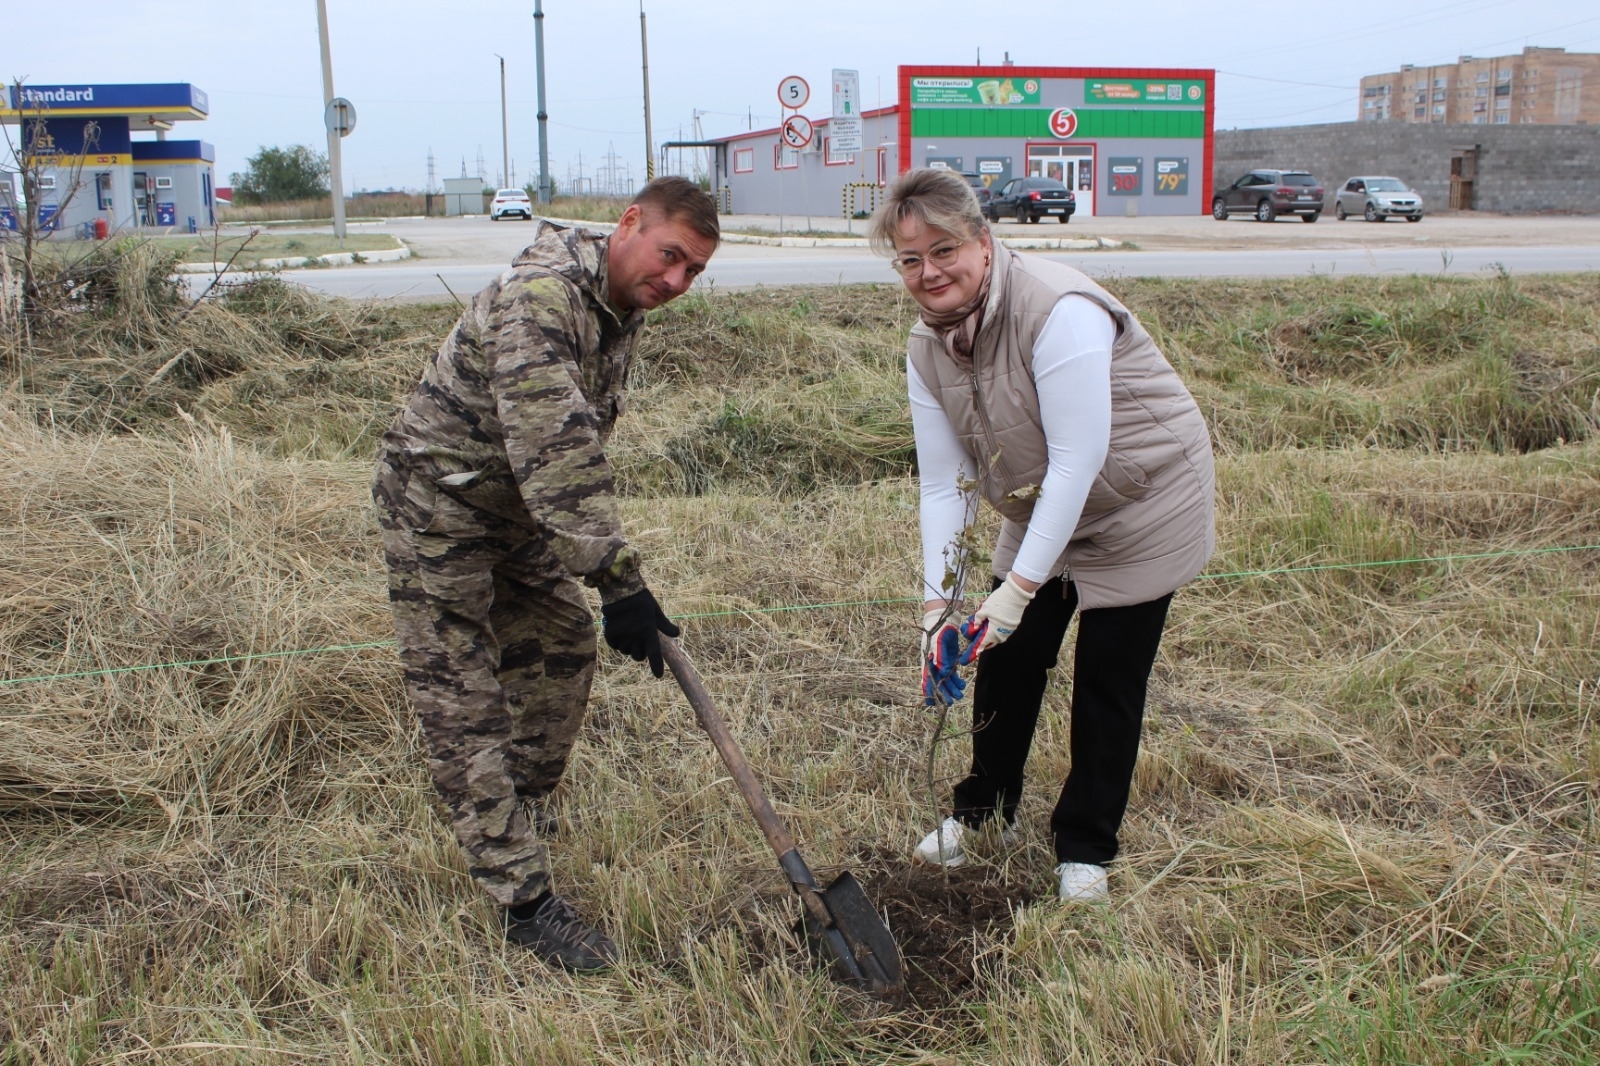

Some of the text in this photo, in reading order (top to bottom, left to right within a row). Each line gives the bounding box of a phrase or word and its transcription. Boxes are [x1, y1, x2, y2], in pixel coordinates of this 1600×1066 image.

[19, 87, 94, 102] standard
[790, 85, 799, 99] 5
[1056, 111, 1070, 133] 5
[111, 156, 118, 164] 2
[1113, 174, 1134, 191] 30
[1159, 174, 1179, 191] 79
[162, 213, 170, 223] 2
